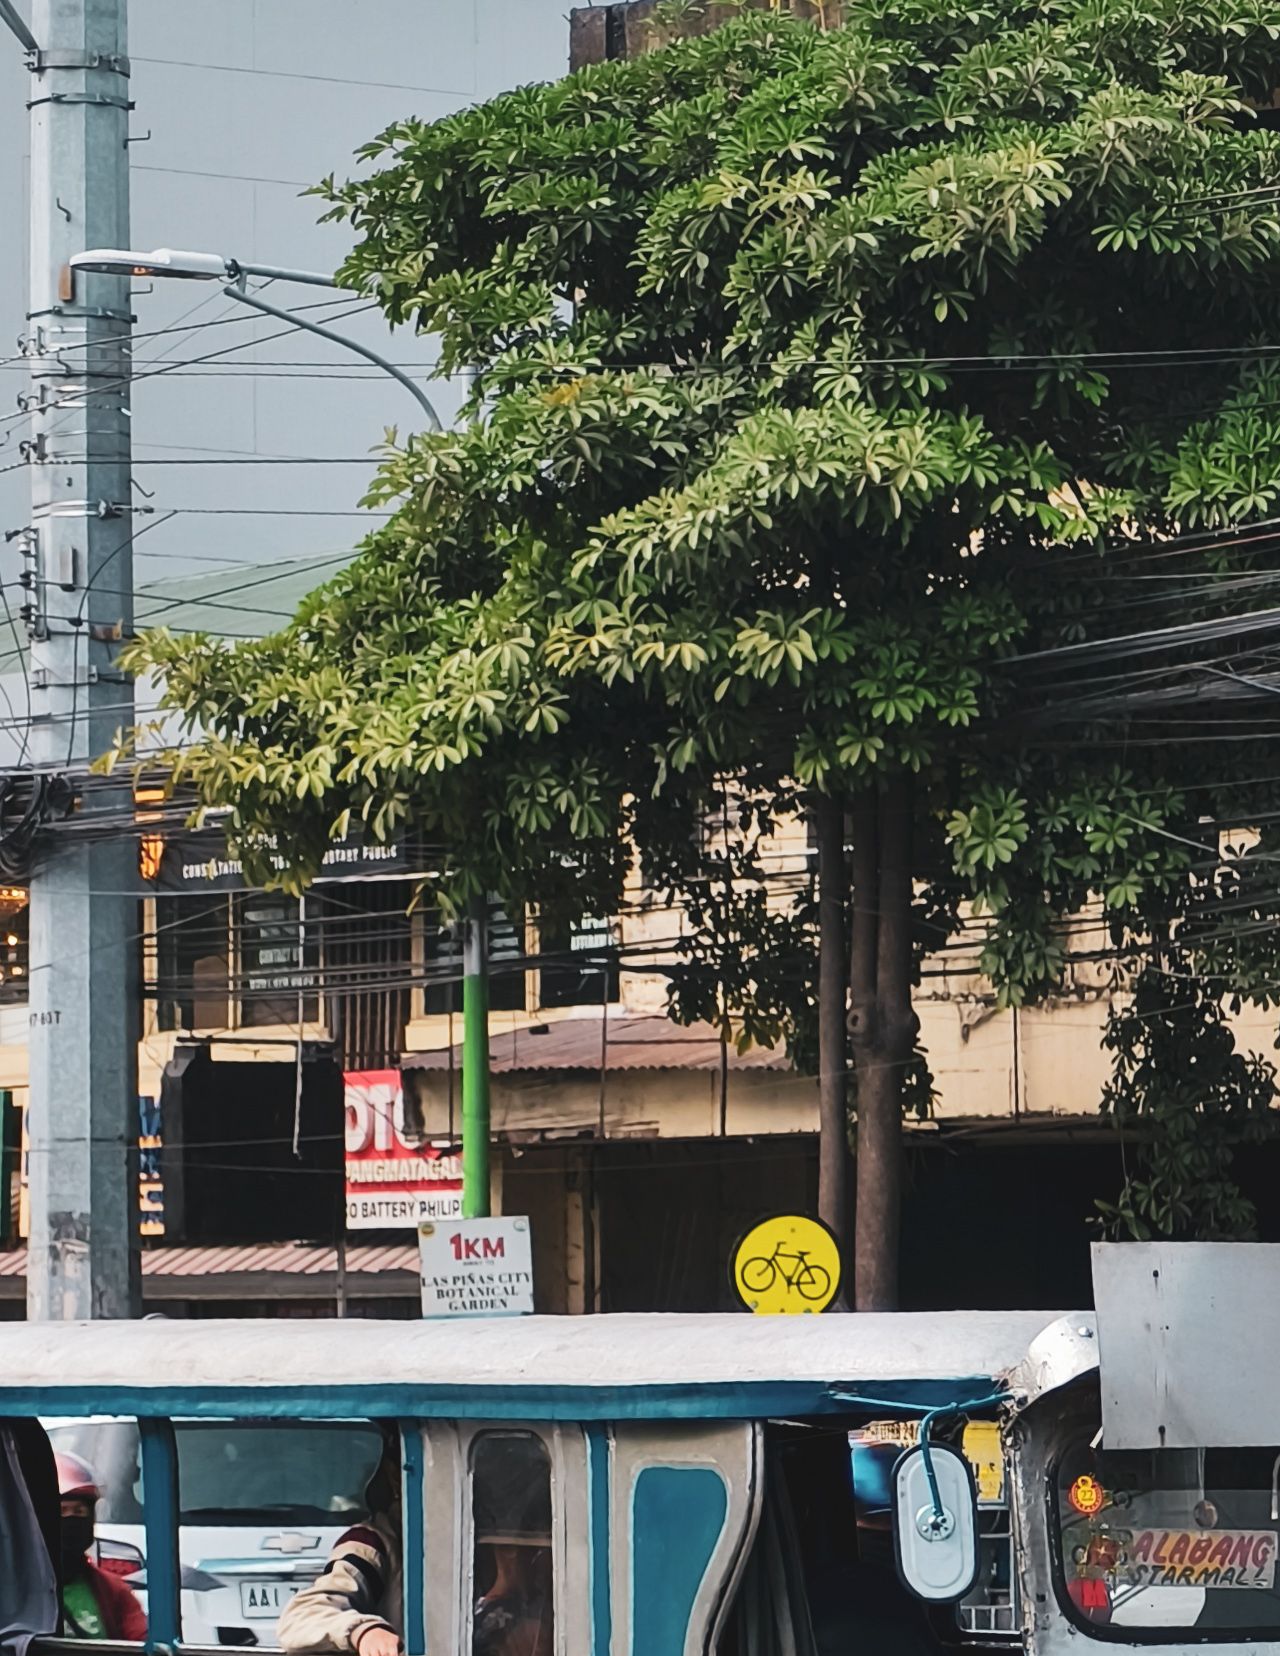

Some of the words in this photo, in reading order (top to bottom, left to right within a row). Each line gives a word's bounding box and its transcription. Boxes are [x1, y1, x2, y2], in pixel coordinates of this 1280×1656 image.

[362, 1202, 415, 1218] BATTERY
[449, 1232, 505, 1261] 1KM
[421, 1276, 448, 1288] LAS
[452, 1273, 495, 1286] PIÑAS
[498, 1272, 530, 1284] CITY
[436, 1285, 519, 1300] BOTANICAL
[448, 1299, 508, 1311] GARDEN
[1133, 1530, 1277, 1567] ALABANG
